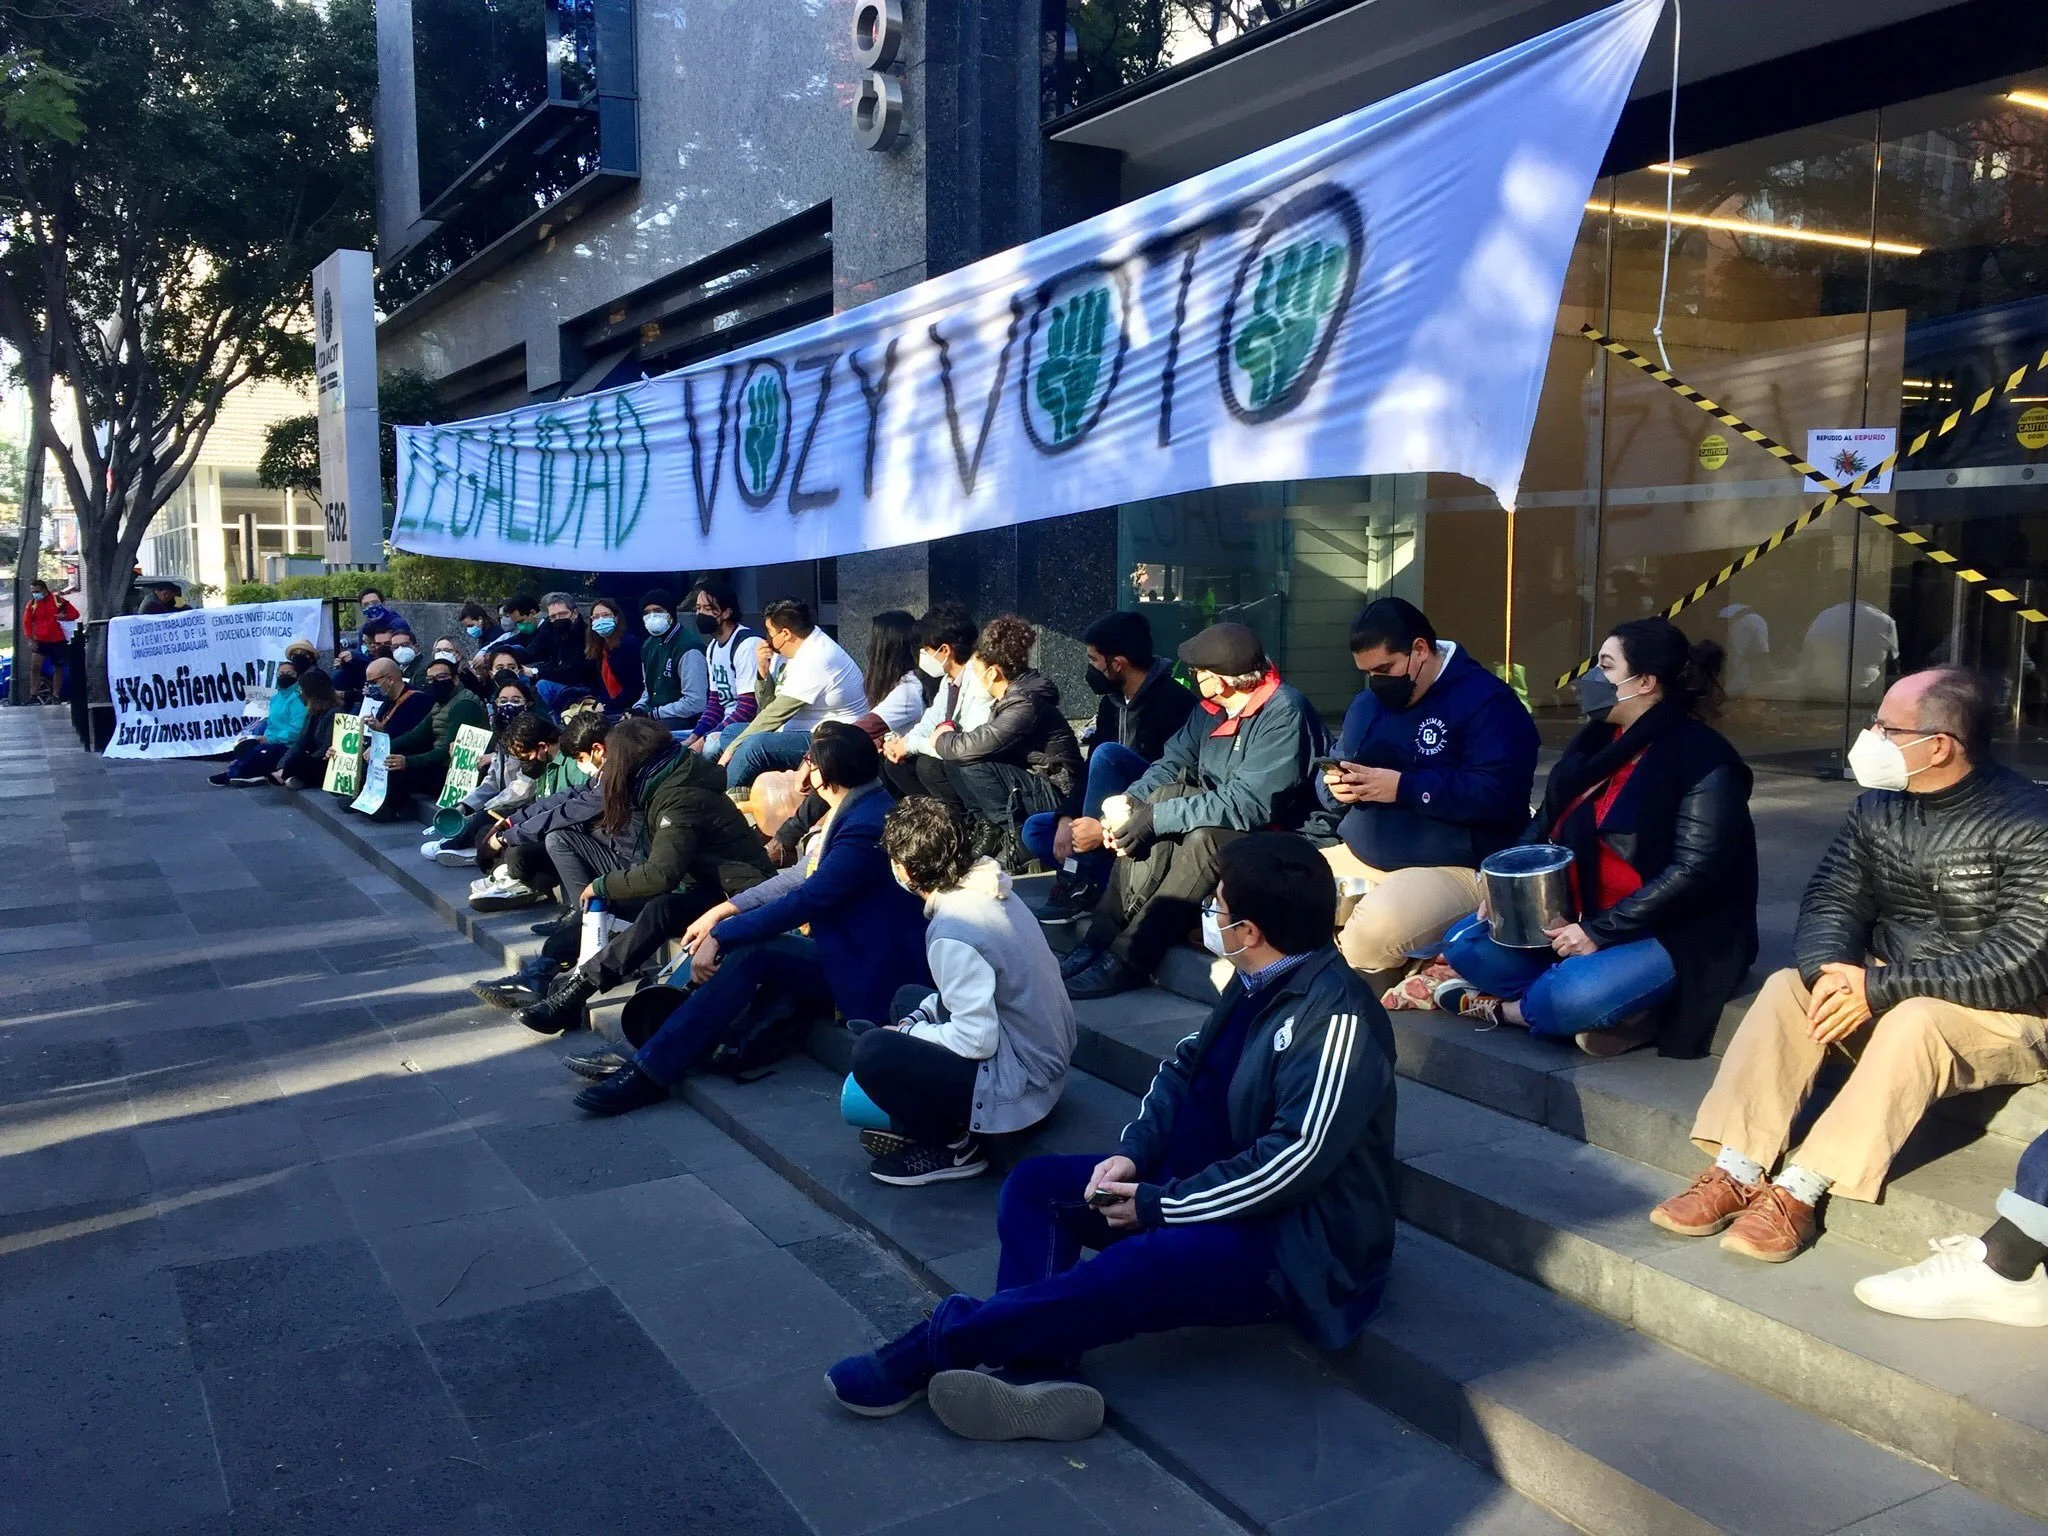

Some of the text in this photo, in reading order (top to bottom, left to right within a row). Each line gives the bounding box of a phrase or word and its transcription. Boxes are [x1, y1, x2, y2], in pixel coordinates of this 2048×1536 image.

[684, 349, 841, 535] VOZ
[850, 338, 899, 498] Y
[929, 182, 1365, 498] VOTO
[324, 501, 348, 543] 1582
[161, 614, 206, 630] TRABAJADORES
[212, 615, 234, 627] CENTRO
[234, 614, 244, 625] DE
[184, 629, 195, 640] DE
[116, 718, 186, 751] Exigimos
[187, 721, 201, 741] su
